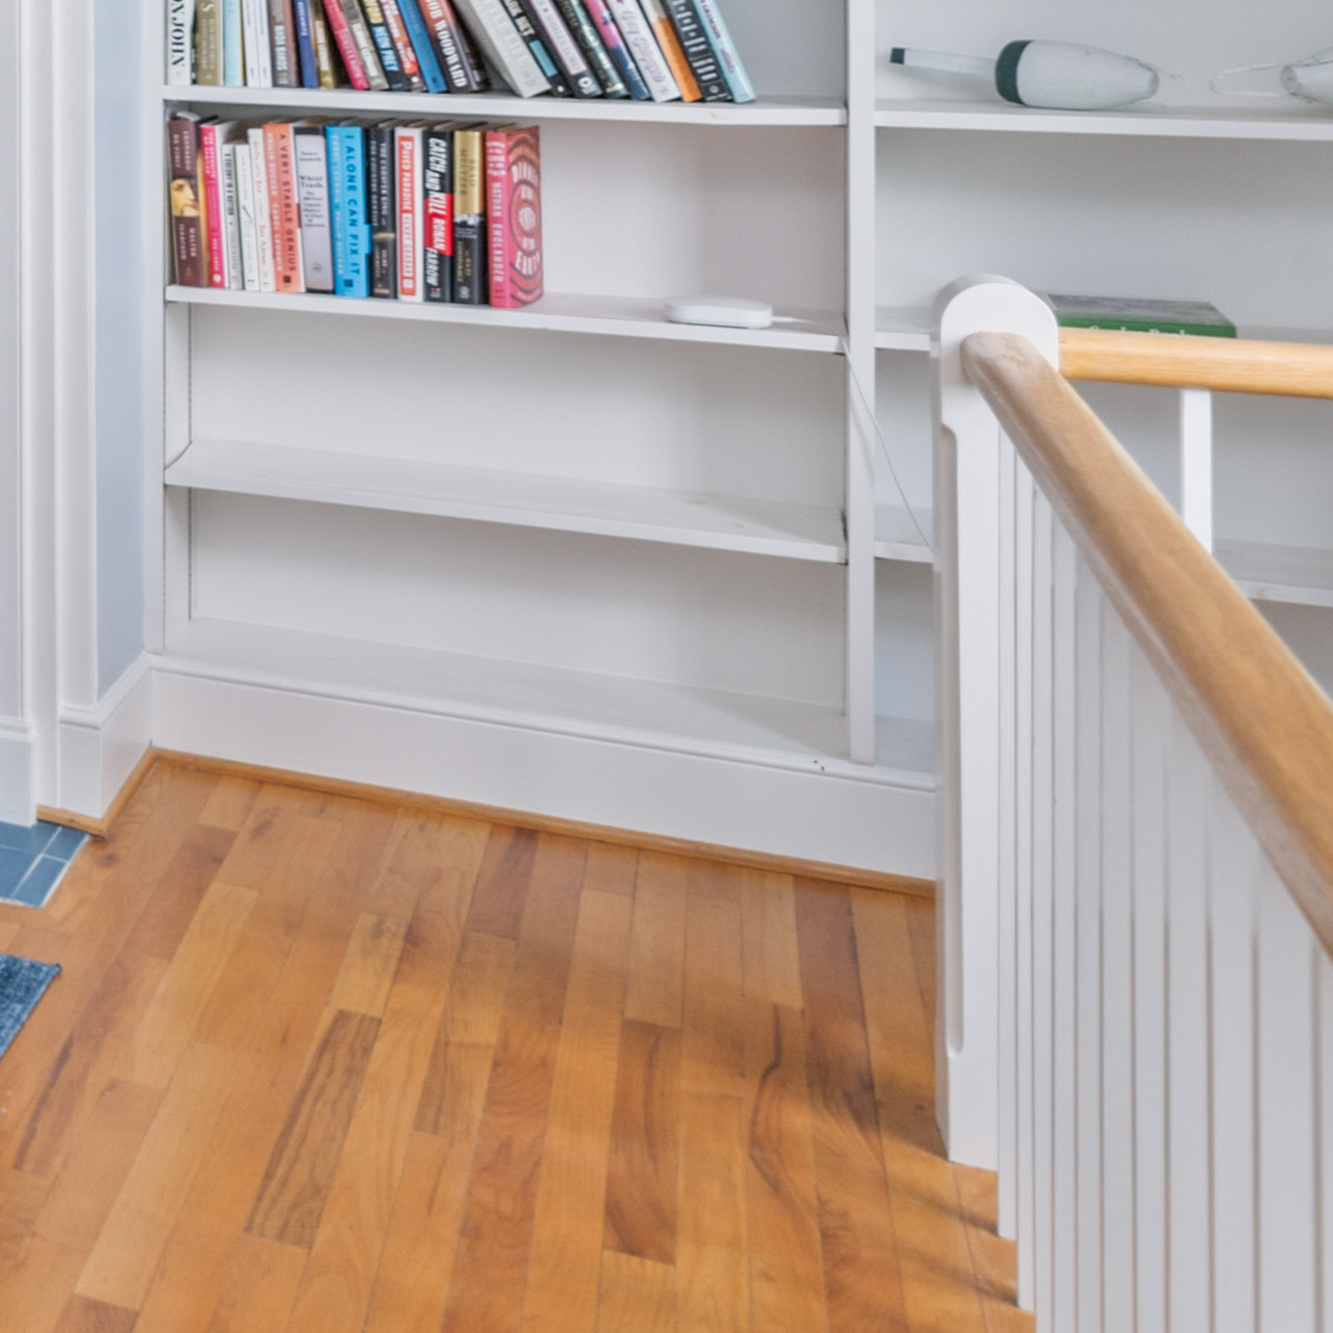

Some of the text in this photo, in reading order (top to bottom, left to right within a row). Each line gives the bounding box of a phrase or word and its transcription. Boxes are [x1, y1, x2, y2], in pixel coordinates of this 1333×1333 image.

[171, 18, 184, 67] JOHN
[372, 23, 390, 49] NEON
[513, 14, 535, 39] NET
[380, 47, 399, 74] PREY
[433, 17, 468, 89] WOODWARD
[183, 131, 191, 170] LEONARDO
[280, 146, 289, 174] VERY
[400, 141, 412, 170] PAVED
[266, 132, 275, 160] PHILIP
[271, 203, 280, 231] CAROL
[346, 146, 359, 192] ALONE
[282, 181, 293, 223] STABLE
[402, 172, 412, 210] PARADISE
[492, 182, 502, 217] NATHAN
[348, 199, 359, 227] CAN
[425, 138, 446, 286] CATCH AND KILL RONAN FARROW
[189, 228, 197, 257] WALTER
[286, 229, 296, 272] GENIUS
[349, 234, 359, 255] FIX
[404, 244, 413, 274] GRABAR
[493, 223, 505, 282] ENGLANDER
[351, 263, 360, 275] IT
